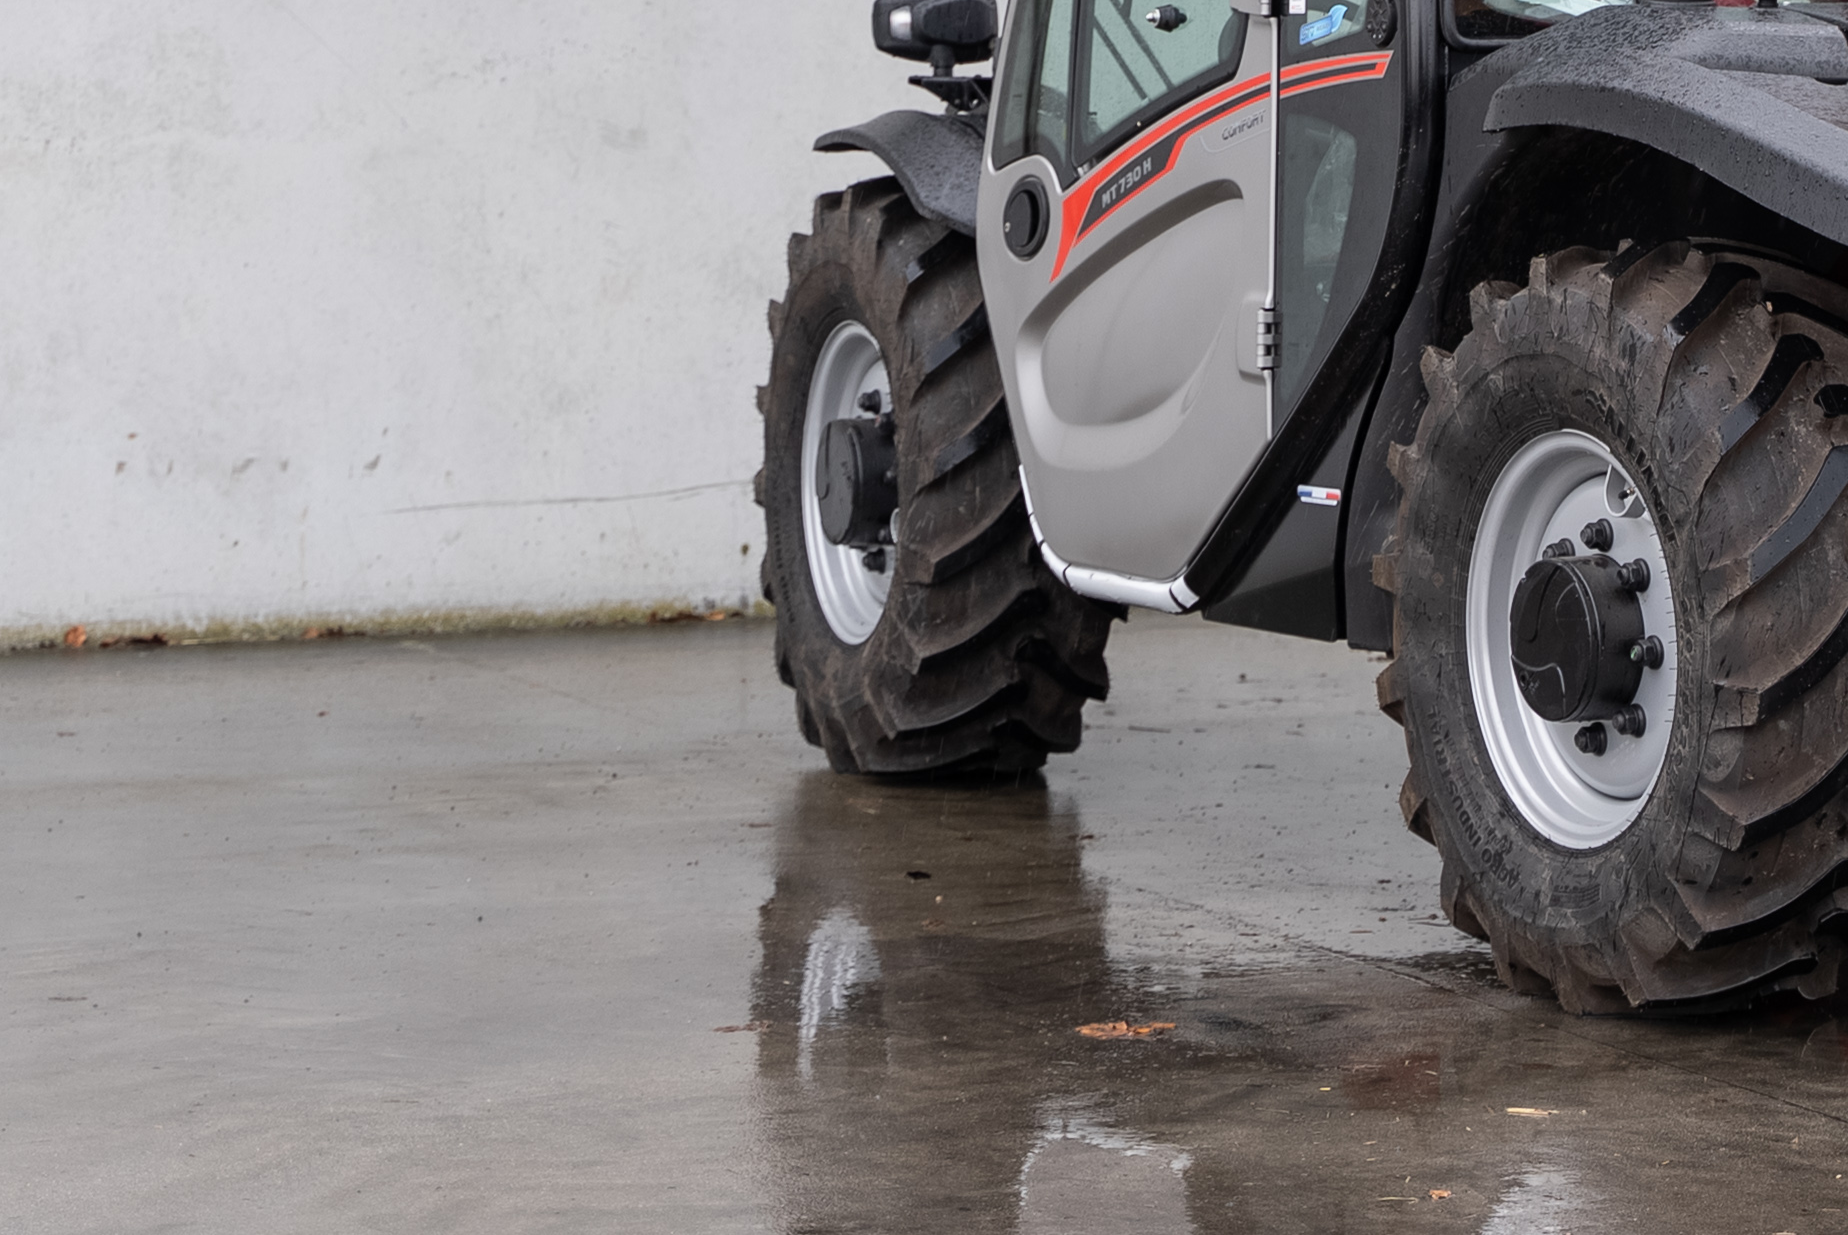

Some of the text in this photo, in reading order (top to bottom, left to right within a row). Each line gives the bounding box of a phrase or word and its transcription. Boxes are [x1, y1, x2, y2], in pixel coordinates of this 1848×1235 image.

[1102, 157, 1152, 208] MT 730 H
